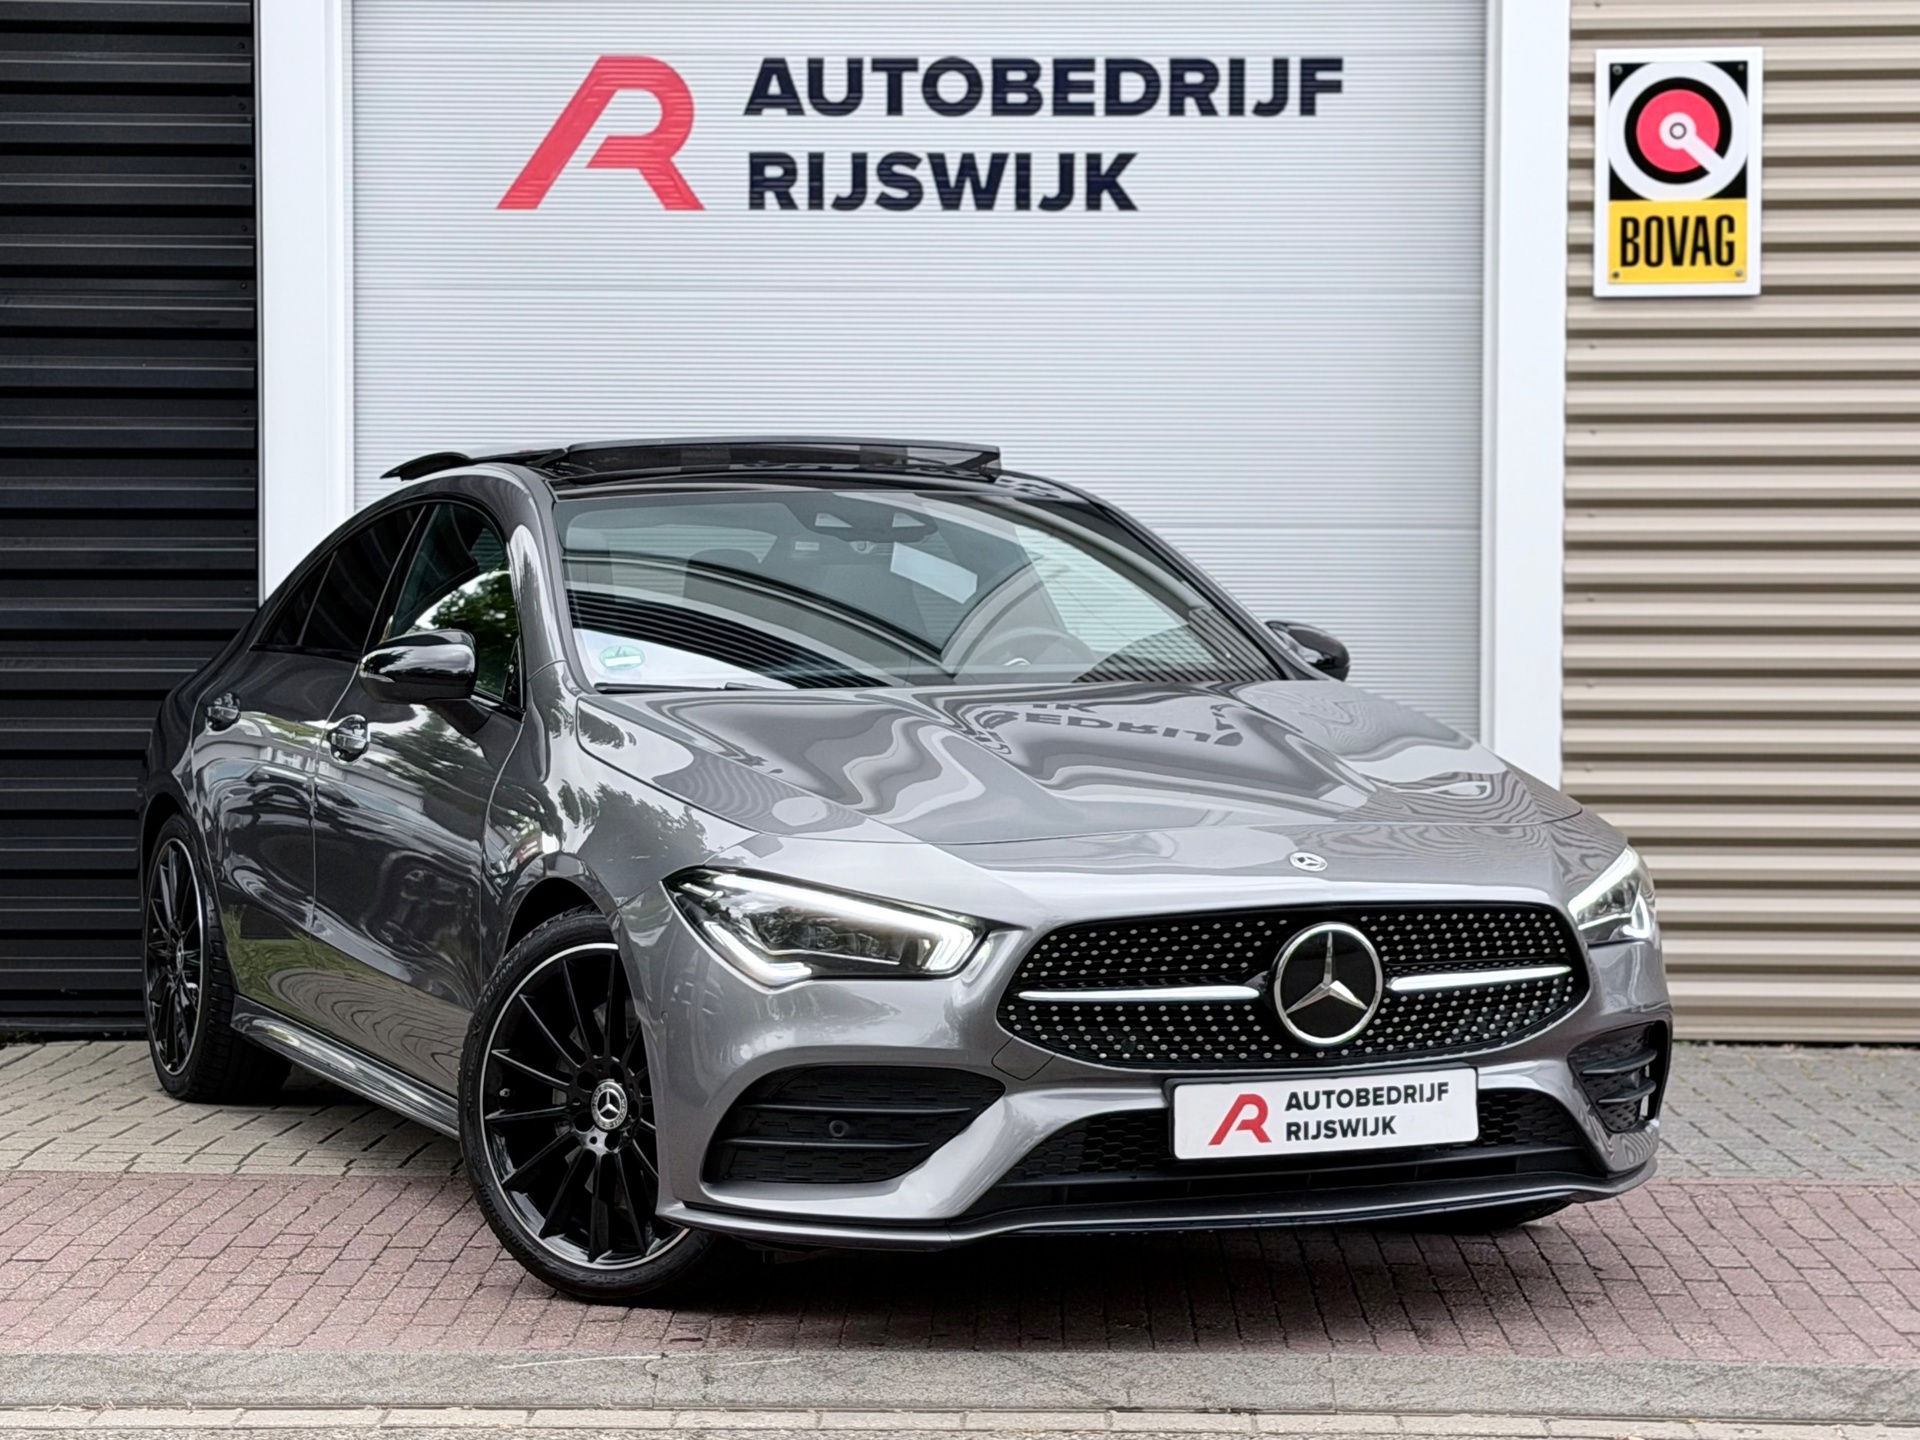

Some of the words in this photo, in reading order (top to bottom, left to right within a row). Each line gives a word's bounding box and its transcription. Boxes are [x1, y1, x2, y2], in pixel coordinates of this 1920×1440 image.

[744, 56, 1343, 117] AUTOBEDRIJF
[749, 151, 1137, 212] RIJSWIJK
[1620, 214, 1735, 268] BOVAG
[1284, 1081, 1449, 1112] AUTOBEDRIJF
[1286, 1115, 1397, 1142] RIJSWIJK
